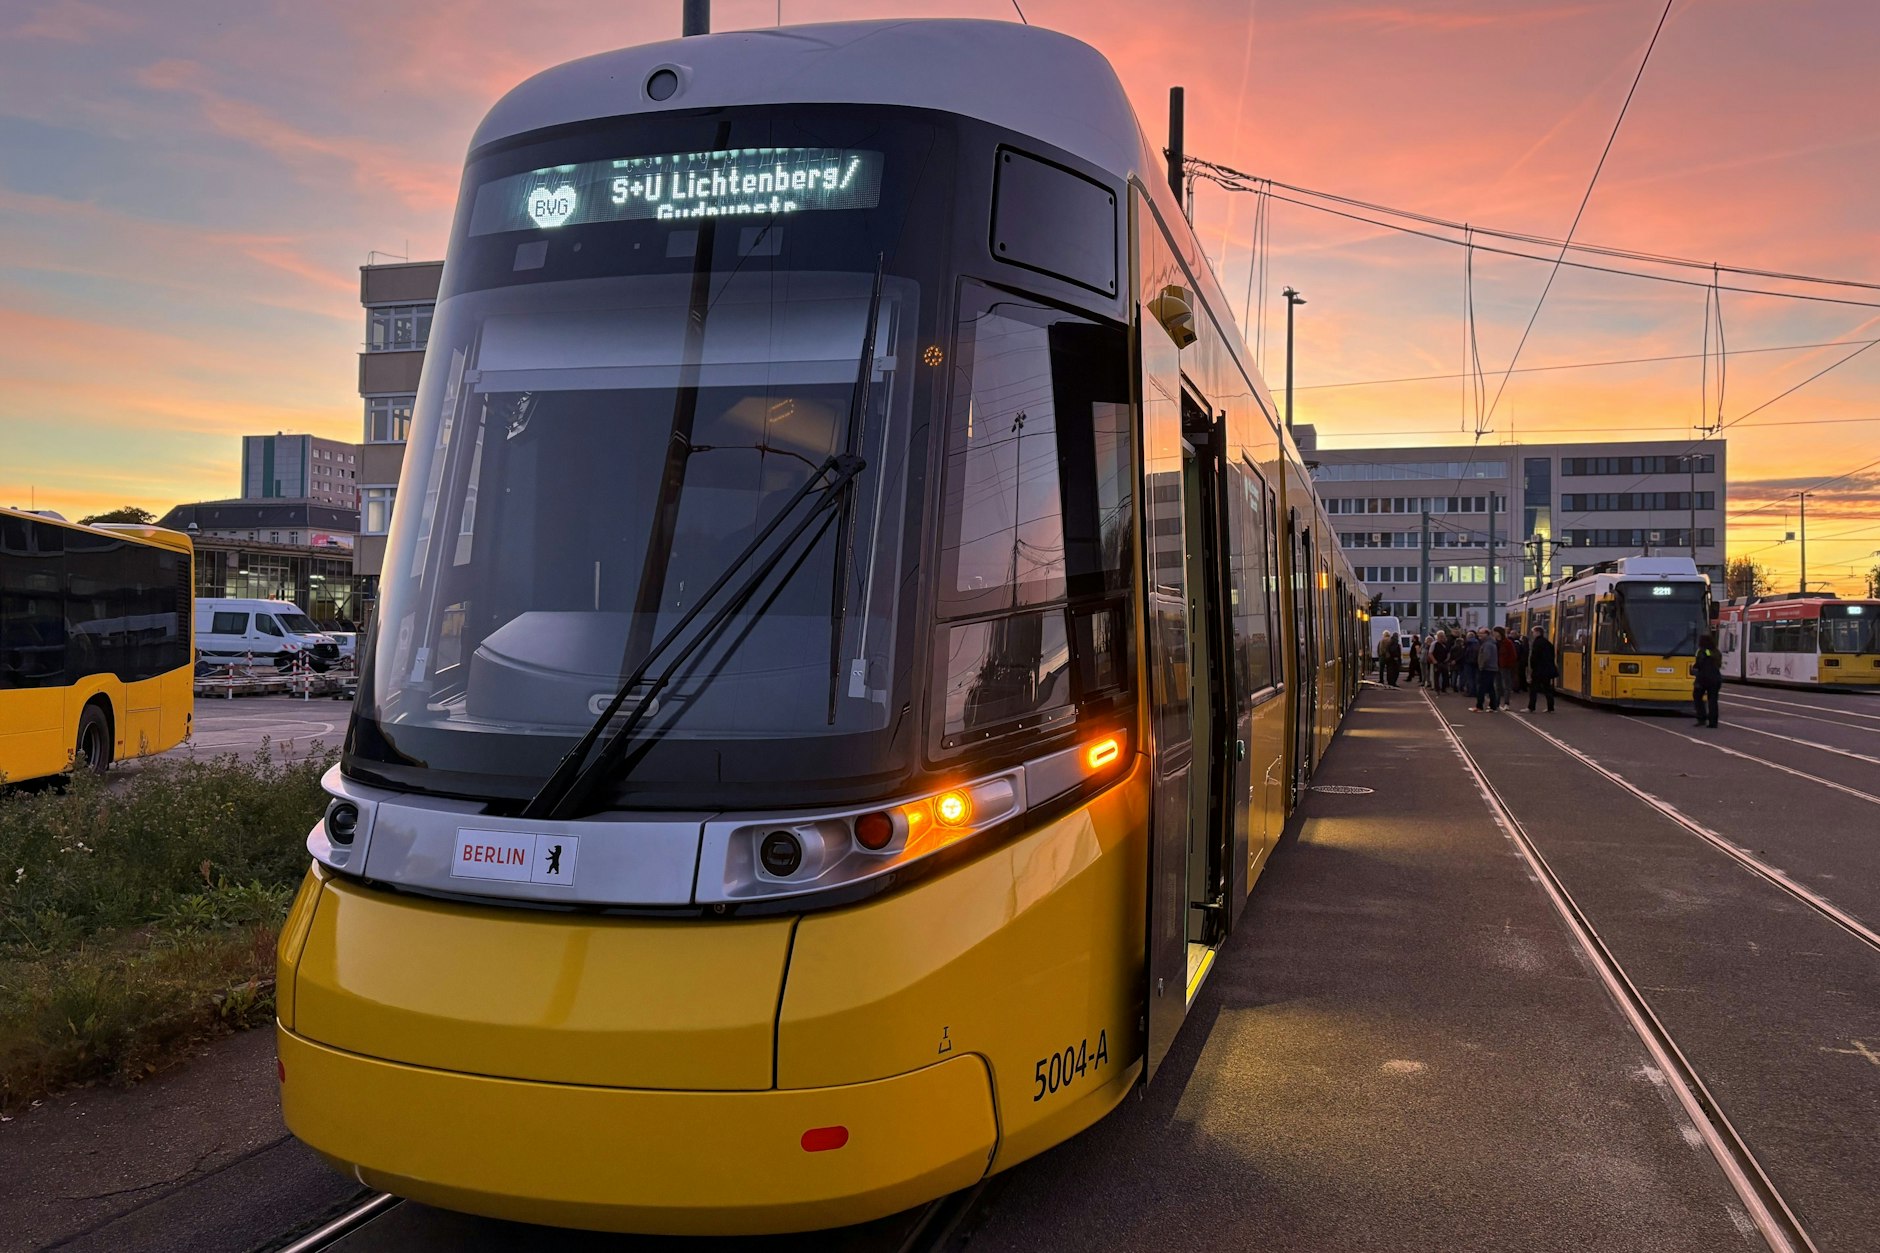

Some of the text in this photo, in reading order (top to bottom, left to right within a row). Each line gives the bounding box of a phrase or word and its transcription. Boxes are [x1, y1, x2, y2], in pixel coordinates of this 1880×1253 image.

[612, 155, 860, 204] S+U Lichtenberg/
[535, 198, 568, 217] BVG
[463, 844, 525, 866] BERLIN
[1033, 1029, 1109, 1102] 5004-A
